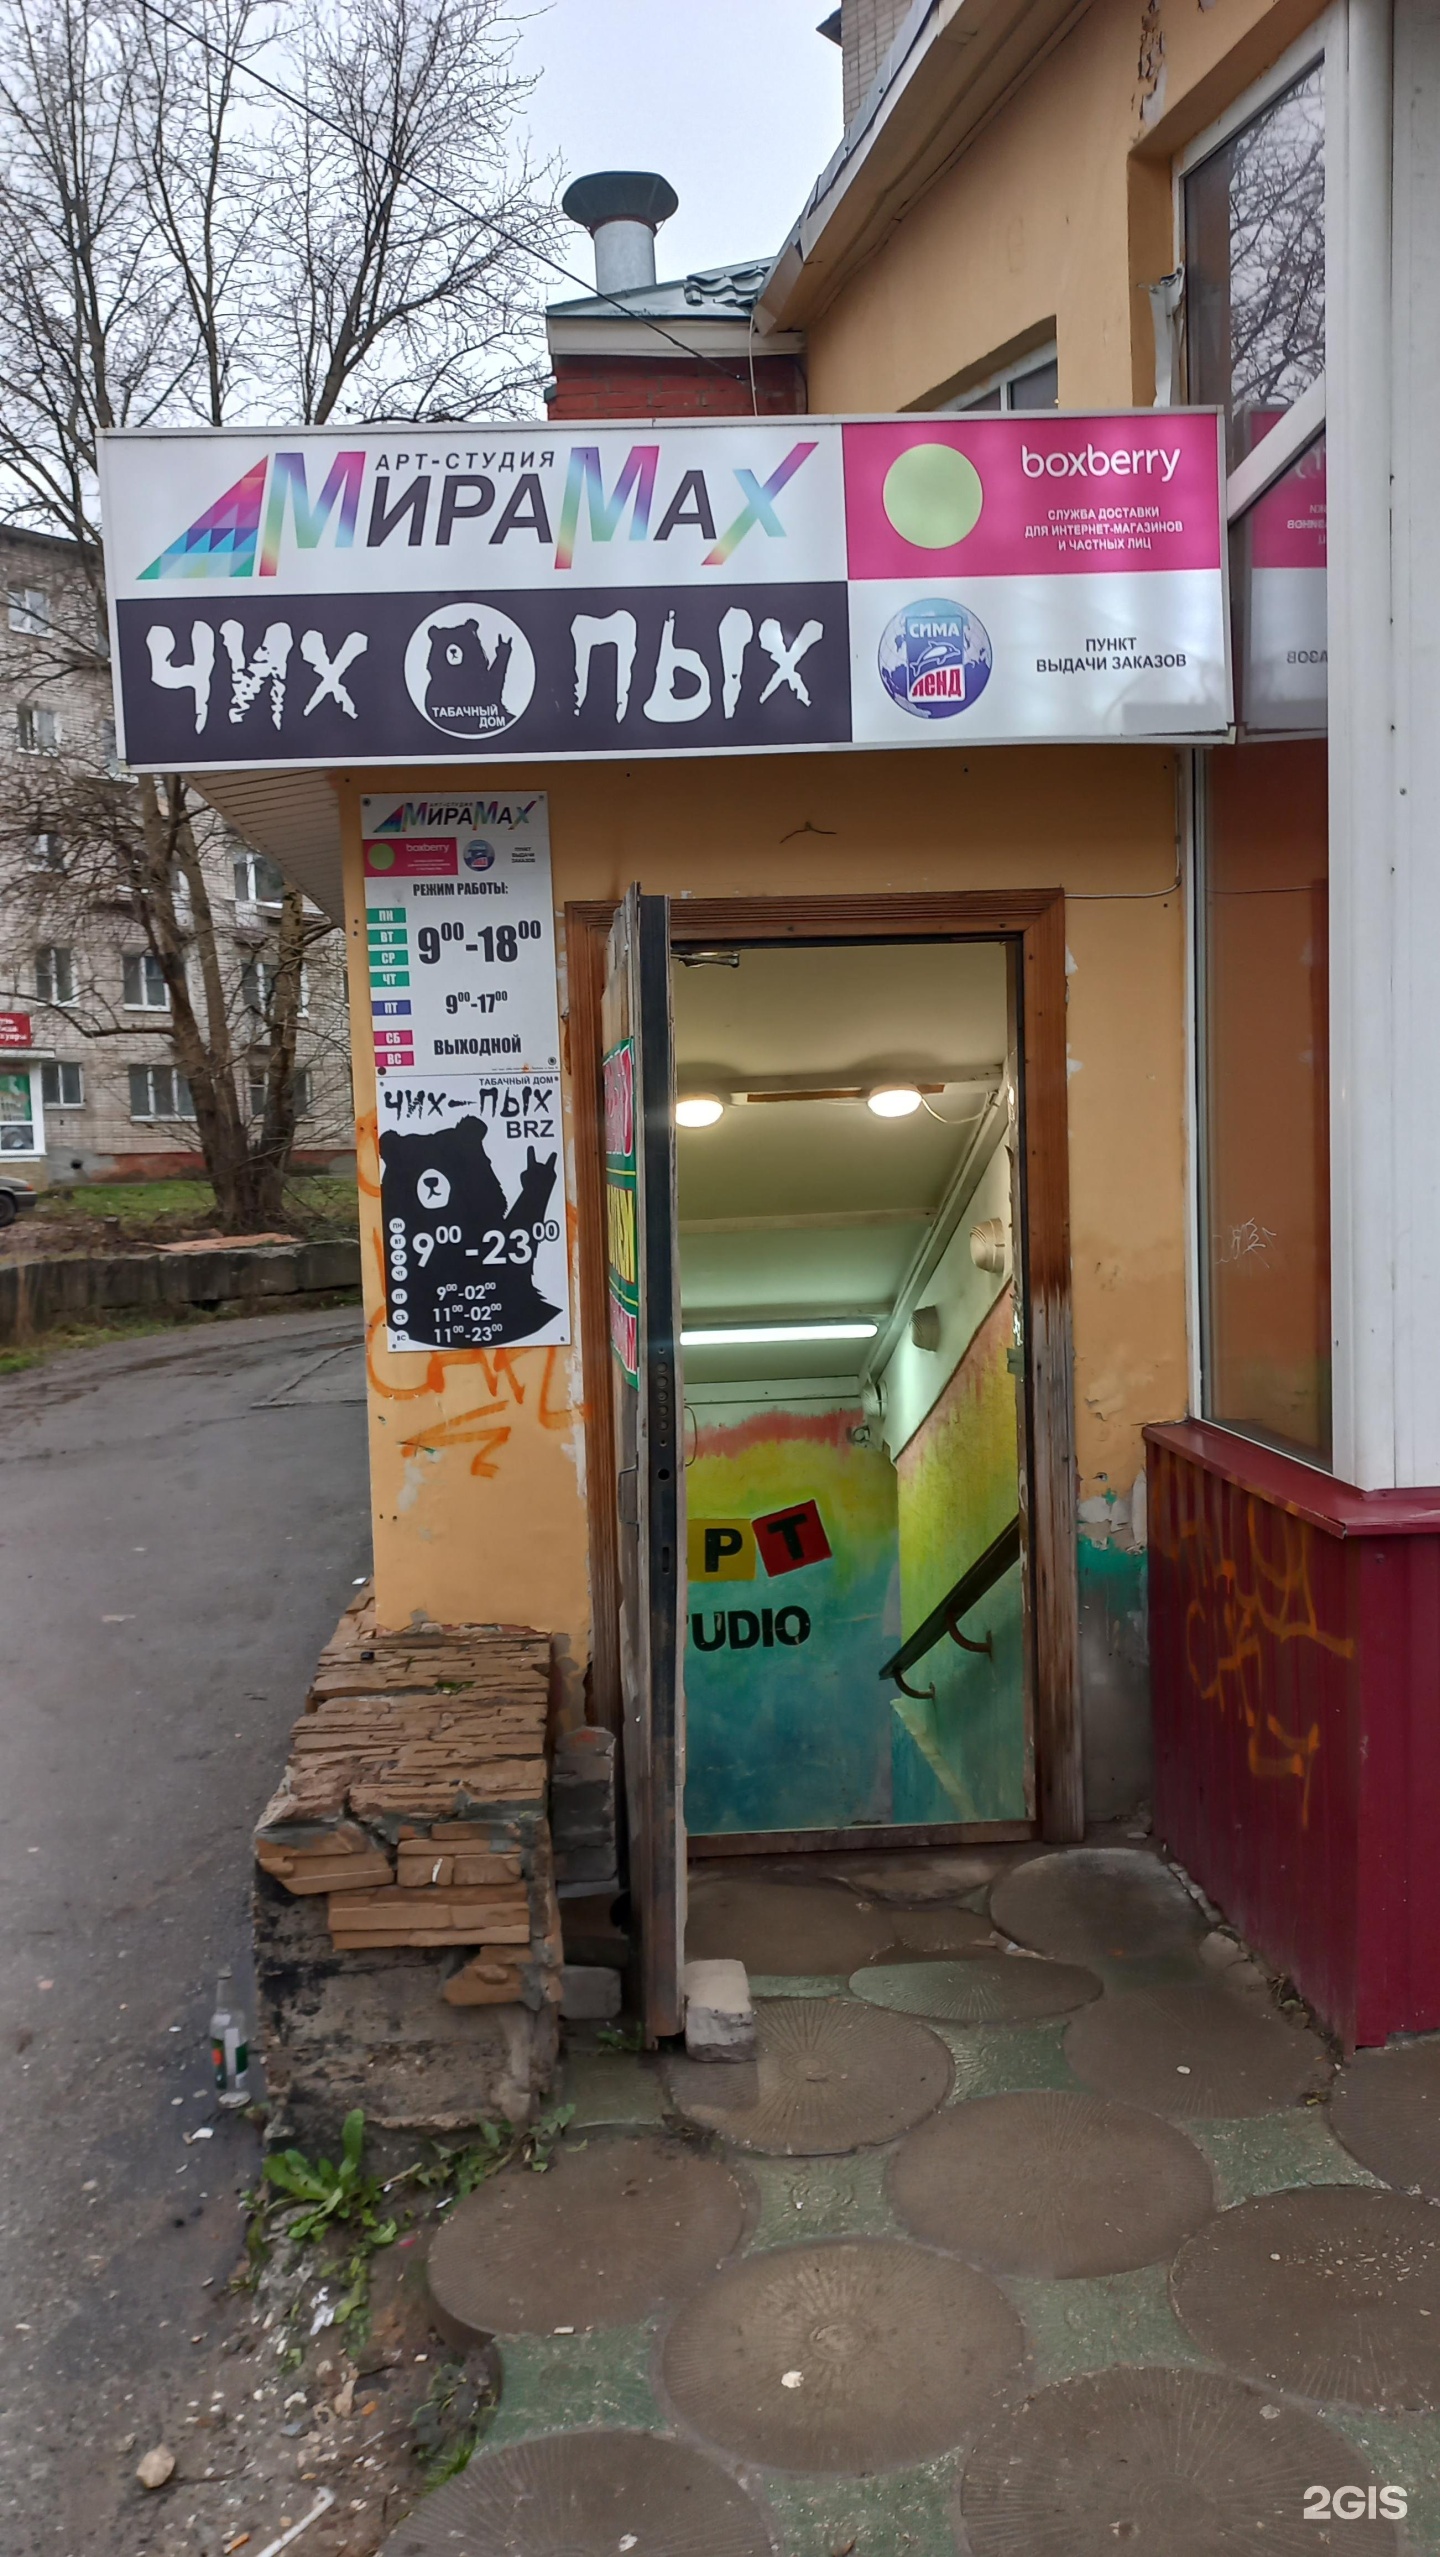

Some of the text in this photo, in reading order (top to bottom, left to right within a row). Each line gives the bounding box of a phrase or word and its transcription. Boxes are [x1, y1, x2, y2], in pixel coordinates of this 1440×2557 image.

[375, 450, 556, 473] АРТ-СТУДИЯ
[1021, 444, 1181, 482] boxberry
[1048, 506, 1160, 521] СЛУЖБА ДОСТАВКИ
[1025, 521, 1183, 539] ДЛЯ ИНТЕРНЕТ-МАГАЗИНОВ
[1058, 537, 1152, 551] И ЧАСТНЫХ ЛИЦ
[909, 621, 960, 639] СИМА
[1085, 637, 1137, 652] ПУНКТ
[145, 606, 825, 735] ЧИХ ПЫХ
[1036, 654, 1187, 674] ВЫДАЧИ ЗАКАЗОВ
[431, 704, 498, 718] ТАБАЧНЫЙ
[479, 716, 505, 728] ДОМ
[406, 843, 450, 854] boxberry
[413, 881, 509, 896] РЕЖИМ РАБОТЫ:
[378, 911, 394, 922] ПН
[380, 931, 394, 943] ВТ
[381, 952, 395, 964] СР
[382, 974, 397, 985] ЧТ
[384, 1002, 398, 1014] ПТ
[386, 1033, 400, 1044] СБ
[433, 1034, 522, 1056] ВЫХОДНОЙ
[387, 1053, 402, 1065] ВС
[478, 1076, 554, 1086] ТАБАЧНЫЙ ДОМ
[506, 1119, 555, 1139] BRZ
[686, 1605, 812, 1652] UDIO
